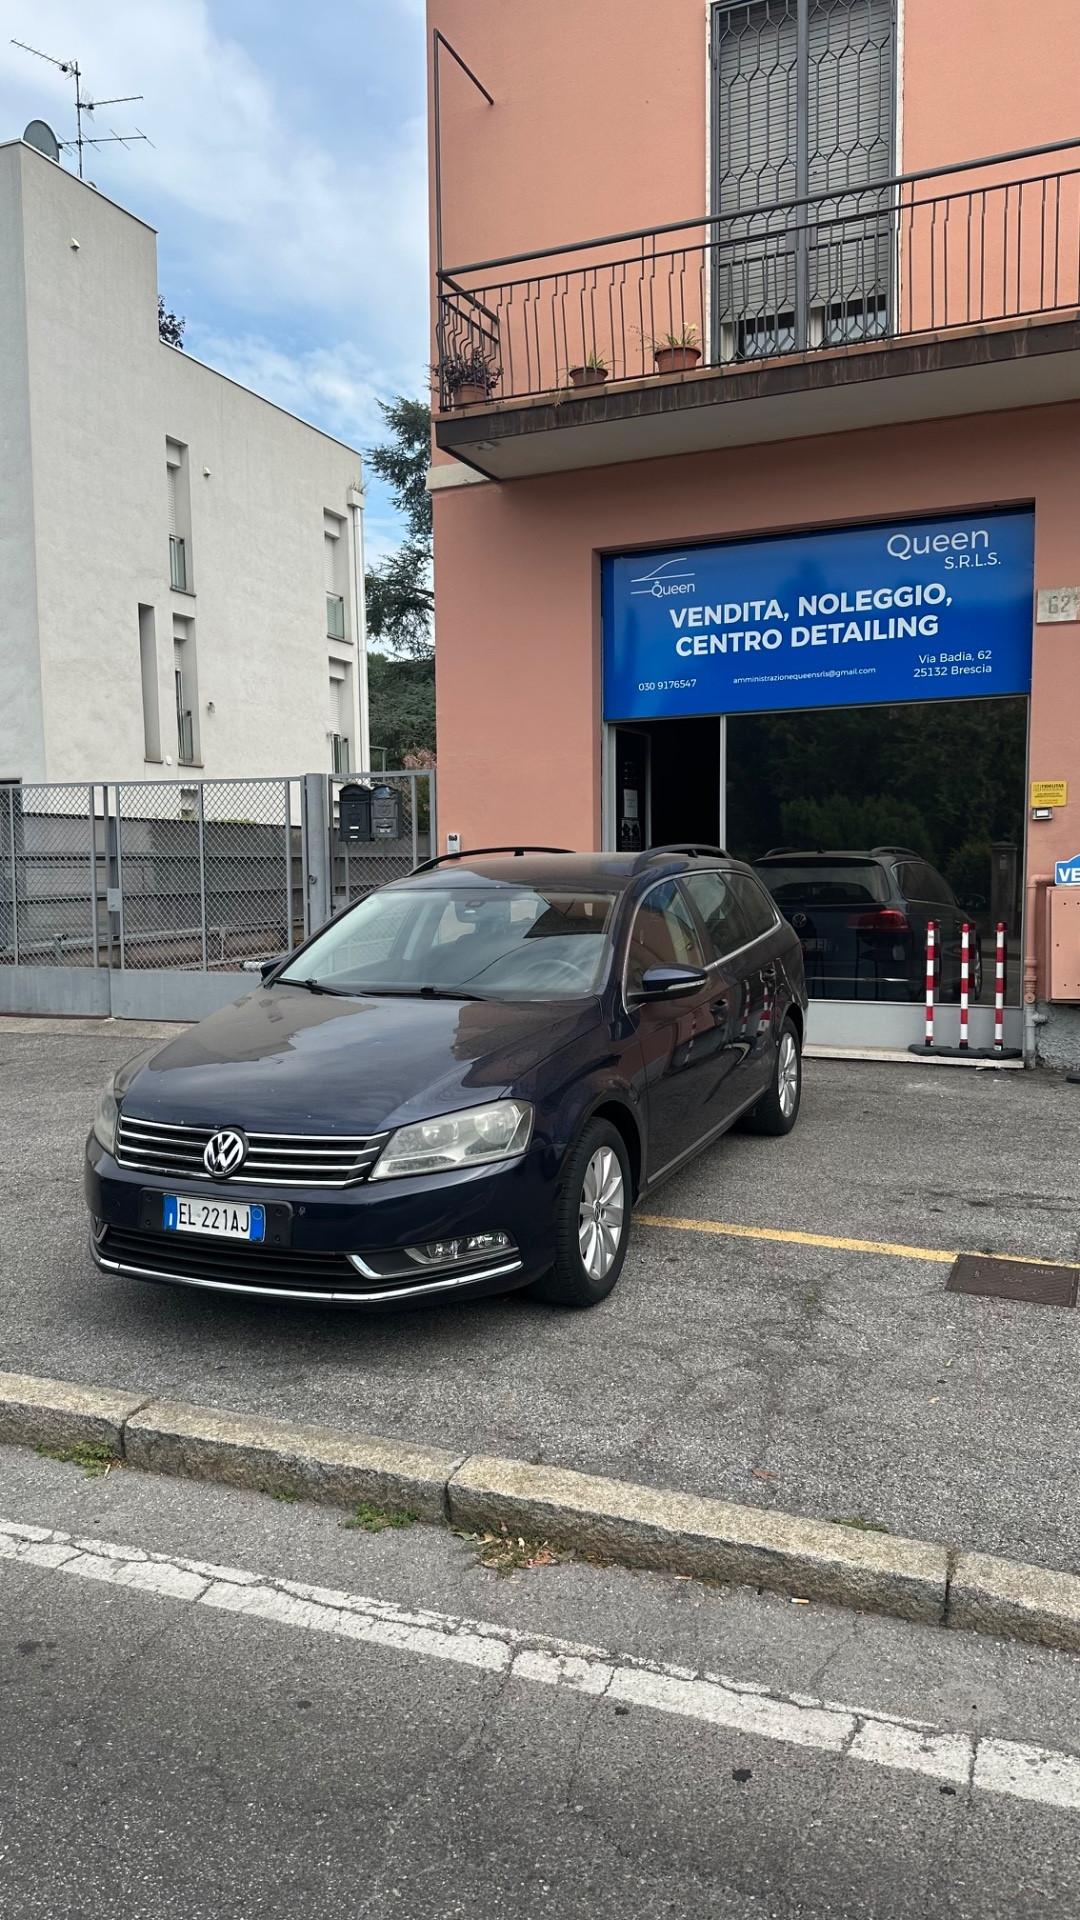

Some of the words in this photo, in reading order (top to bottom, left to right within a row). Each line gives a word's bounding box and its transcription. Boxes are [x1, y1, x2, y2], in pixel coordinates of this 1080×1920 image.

[887, 529, 988, 560] Queen
[944, 552, 1001, 569] S.R.L.S.
[651, 583, 696, 598] Queen
[669, 599, 789, 628] VENDITA,
[798, 583, 953, 616] NOLEGGIO,
[675, 628, 783, 657] CENTRO
[791, 614, 939, 647] DETAILING
[918, 654, 936, 664] Via
[940, 651, 974, 663] Badia,
[977, 650, 992, 660] 62
[913, 666, 948, 678] 25132
[951, 664, 992, 675] Brescia
[638, 682, 655, 692] 030
[657, 678, 697, 690] 9176547
